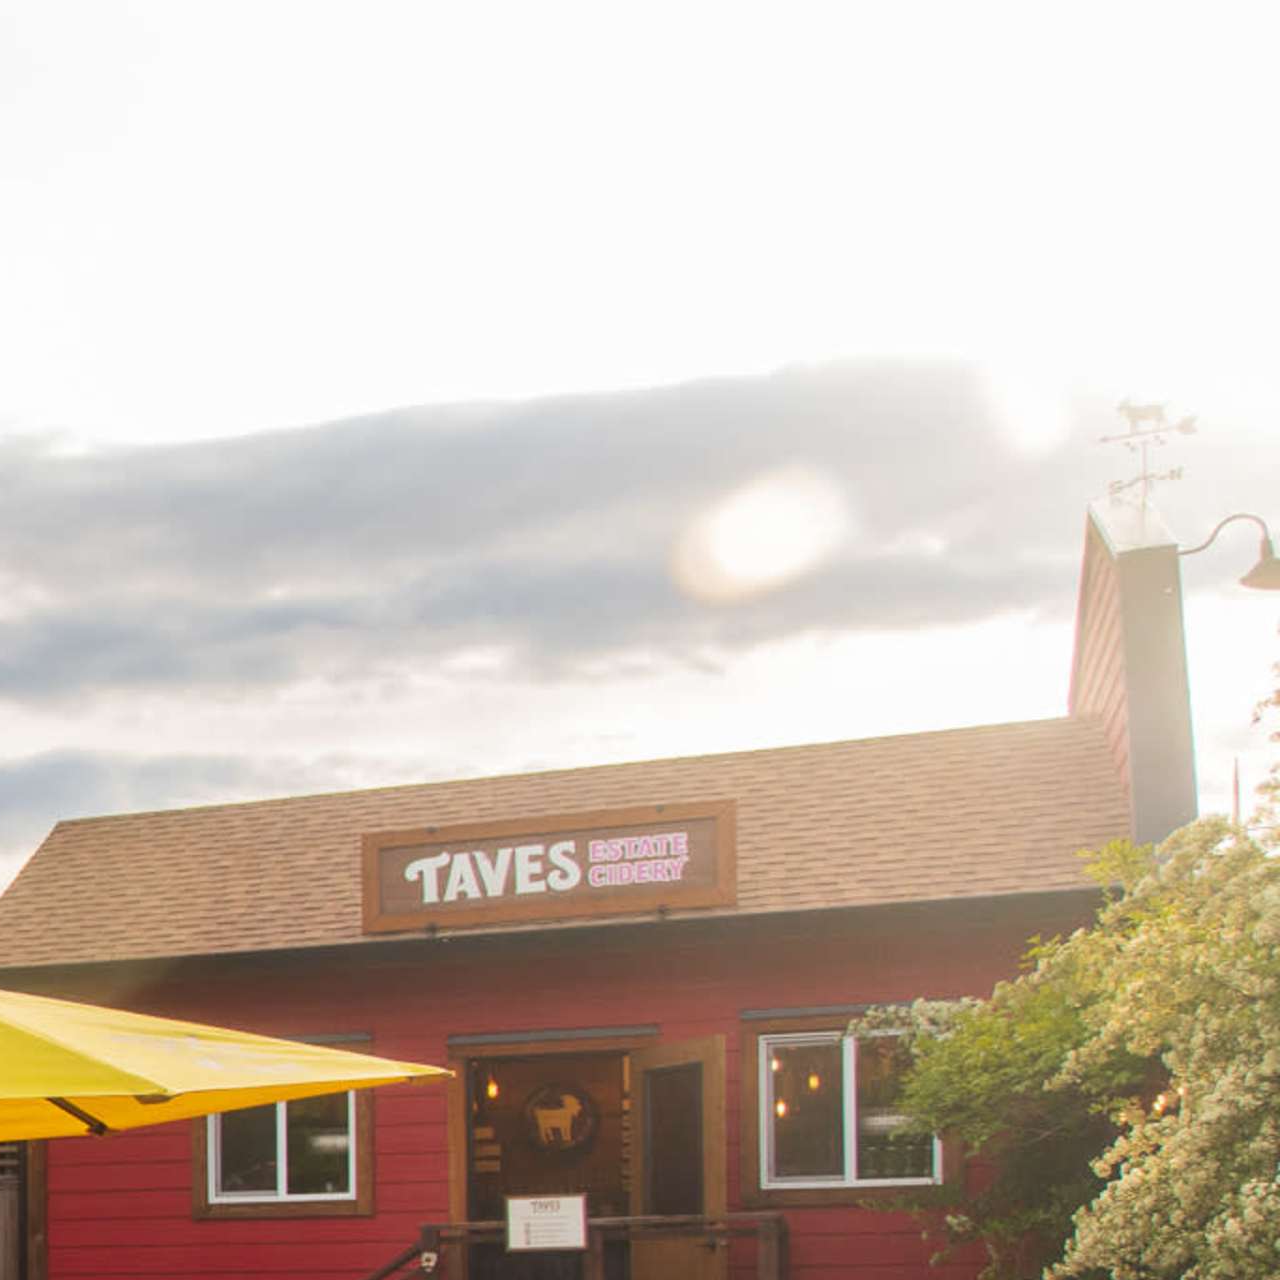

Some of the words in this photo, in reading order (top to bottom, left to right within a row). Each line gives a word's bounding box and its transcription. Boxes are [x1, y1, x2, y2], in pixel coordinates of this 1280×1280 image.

[404, 840, 581, 904] TAVES
[588, 832, 689, 862] ESTATE
[588, 855, 688, 887] CIDERY
